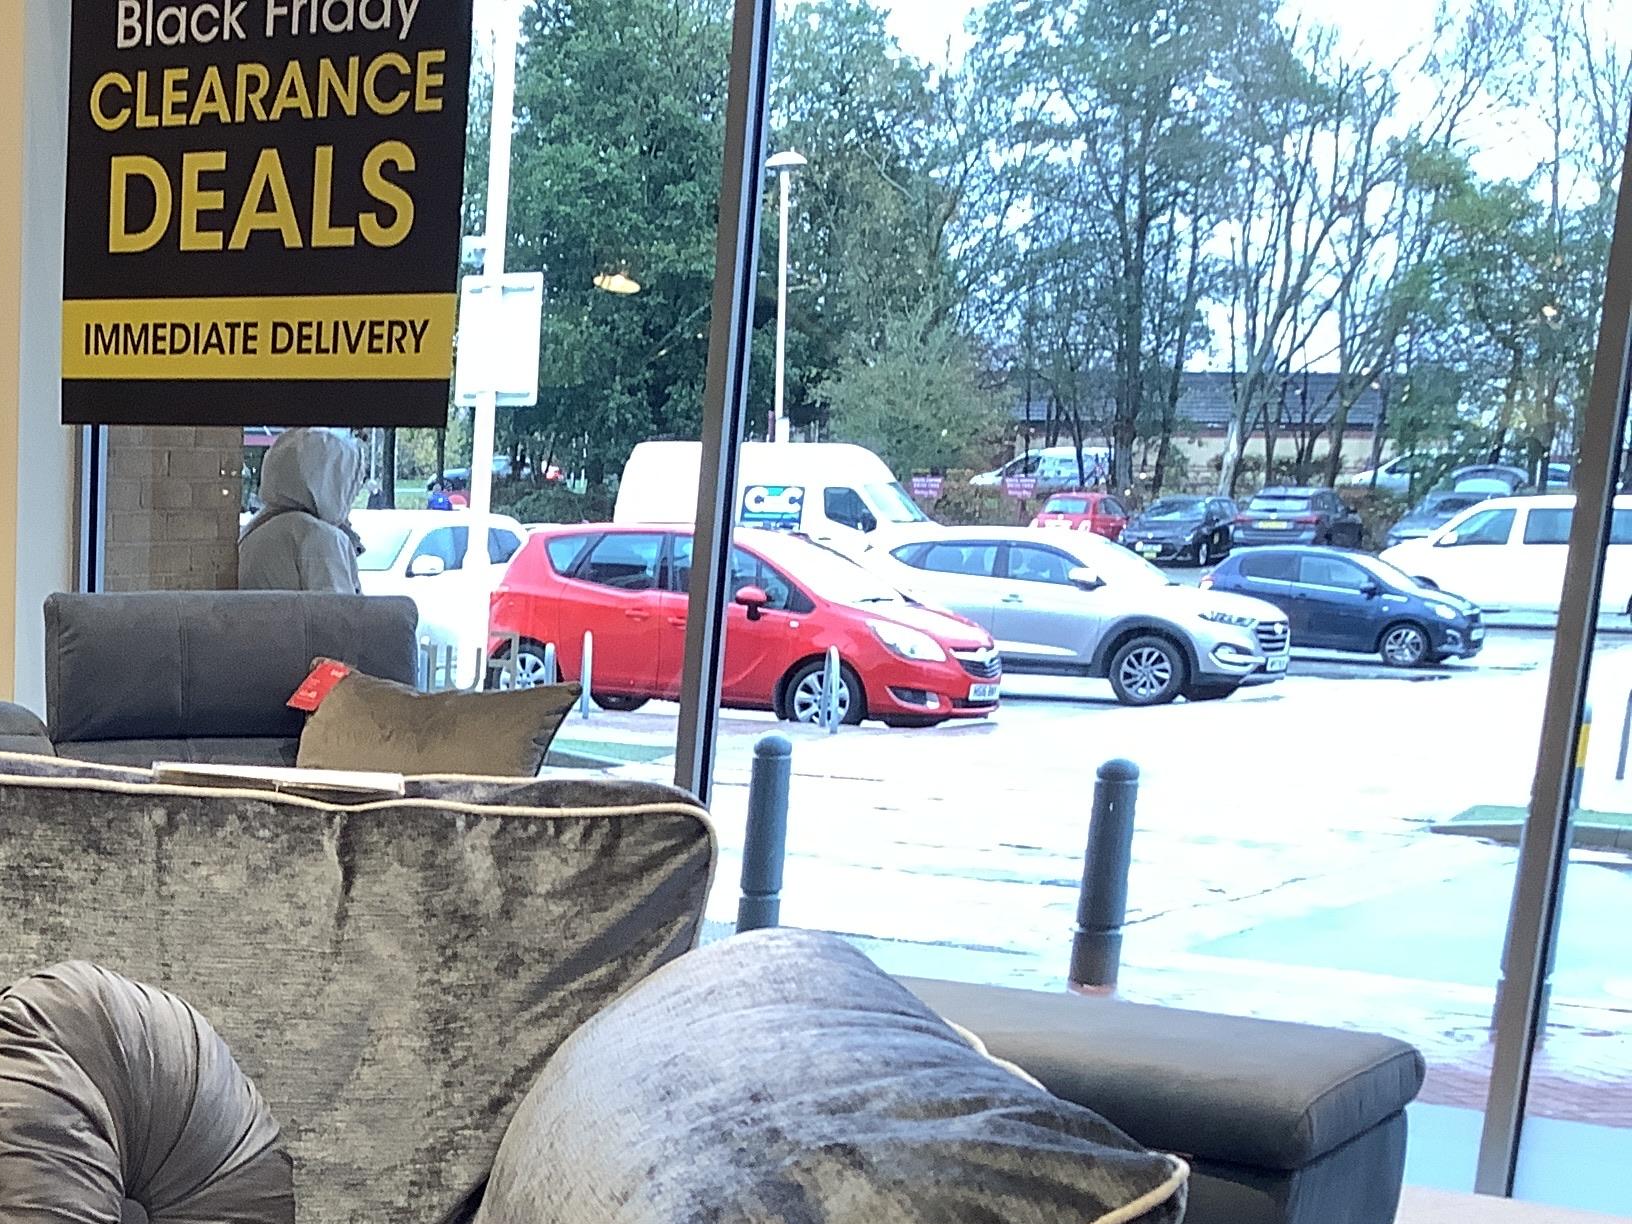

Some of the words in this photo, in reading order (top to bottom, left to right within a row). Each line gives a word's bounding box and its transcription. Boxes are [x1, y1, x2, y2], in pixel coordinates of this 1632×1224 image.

[117, 0, 247, 48] Black
[266, 0, 419, 40] Friday
[90, 50, 446, 131] CLEARANCE
[109, 140, 416, 253] DEALS
[84, 321, 259, 355] IMMEDIATE
[270, 319, 430, 355] DELIVERY
